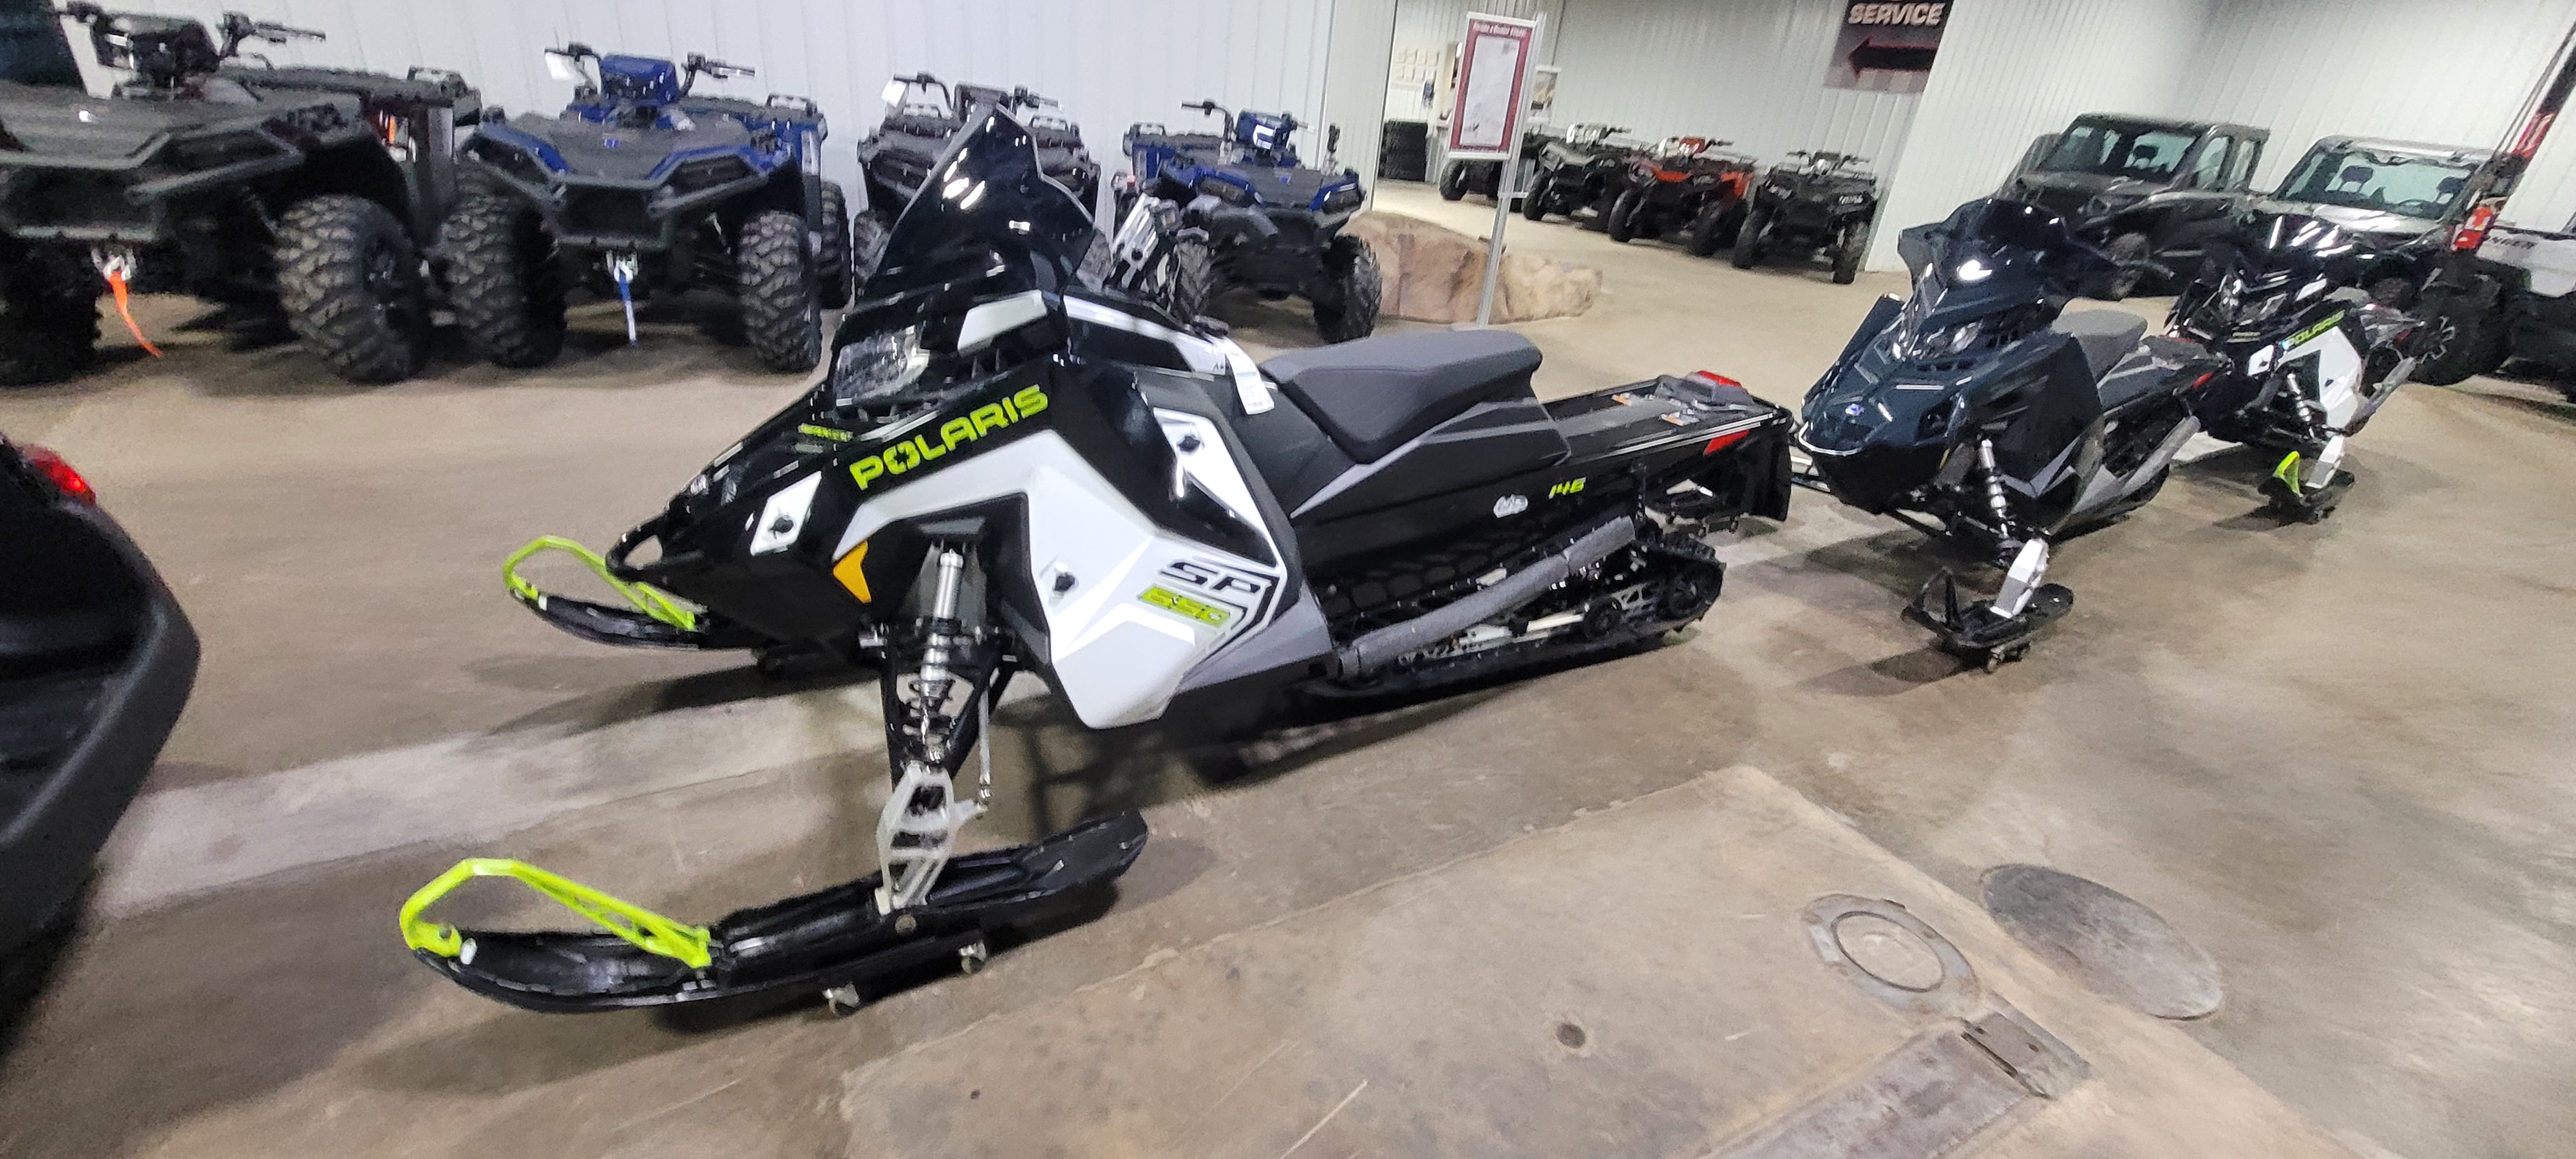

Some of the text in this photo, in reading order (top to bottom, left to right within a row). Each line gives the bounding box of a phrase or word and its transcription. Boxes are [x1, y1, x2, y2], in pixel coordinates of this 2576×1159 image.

[1848, 3, 1946, 26] SERVICE
[2282, 309, 2345, 350] POLARIS
[849, 384, 1048, 491] POLARIS
[1548, 476, 1586, 500] 146
[1158, 561, 1262, 594] SP
